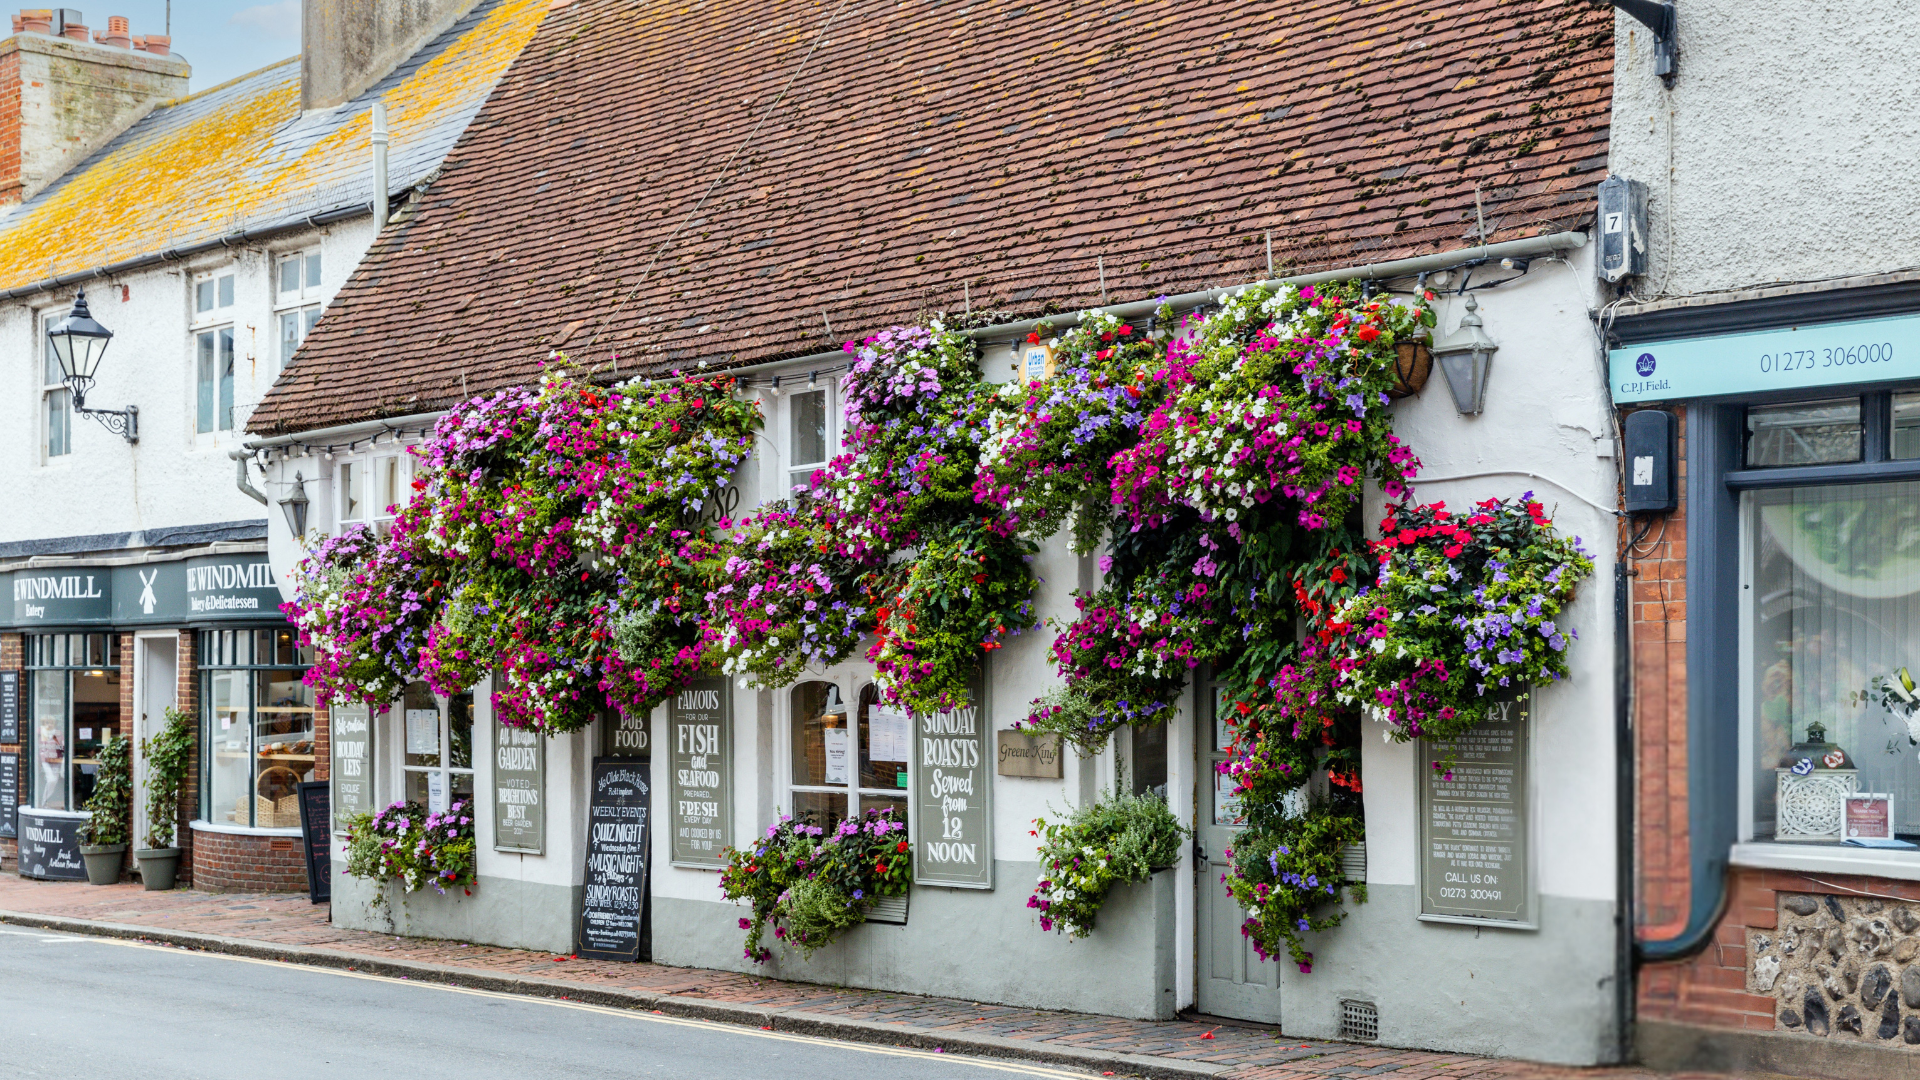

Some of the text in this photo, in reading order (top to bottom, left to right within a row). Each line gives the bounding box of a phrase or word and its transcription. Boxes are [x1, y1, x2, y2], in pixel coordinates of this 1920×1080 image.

[1609, 215, 1619, 230] 7
[1028, 351, 1045, 367] Urban
[1760, 342, 1893, 373] 01273 306000
[1621, 379, 1671, 394] C.P.J. Field.
[197, 563, 277, 591] WINDMIL
[20, 576, 102, 600] WINDMILL
[26, 604, 45, 618] Eatery
[211, 595, 258, 609] Delicatessen
[678, 690, 719, 710] FAMOUS
[698, 713, 708, 721] OUR
[923, 705, 978, 735] SUNDAY
[615, 731, 648, 749] FOOD
[678, 724, 720, 756] FISH
[336, 741, 366, 759] HOLIDAY
[498, 746, 537, 771] GARDEN
[923, 737, 980, 769] ROASTS
[1000, 742, 1056, 765] Greene King
[343, 759, 361, 776] LETS
[506, 778, 530, 789] VOTED
[678, 769, 719, 788] SEAFOOD
[930, 768, 974, 798] Served
[340, 783, 361, 794] ENQUIRE
[499, 788, 538, 806] BRIGHTON'S
[507, 804, 527, 819] BEST
[593, 806, 647, 819] WEEKLY EVENTS
[679, 800, 719, 818] FRESH
[941, 794, 967, 818] from
[502, 818, 533, 828] BEER GARDEN
[683, 815, 713, 825] EVERY DAY
[941, 816, 963, 840] 12
[26, 826, 63, 843] WINDMILL
[592, 822, 645, 843] QUIZ NIGHT
[679, 827, 721, 840] AND COOKED BY US
[690, 840, 700, 850] FOR
[927, 841, 977, 865] NOON
[590, 853, 642, 873] MUSIC NIGHT
[1445, 871, 1468, 884] CALL
[1470, 873, 1482, 885] US
[586, 884, 639, 902] SUNDAY ROASTS
[1440, 886, 1502, 901] 01273 300491
